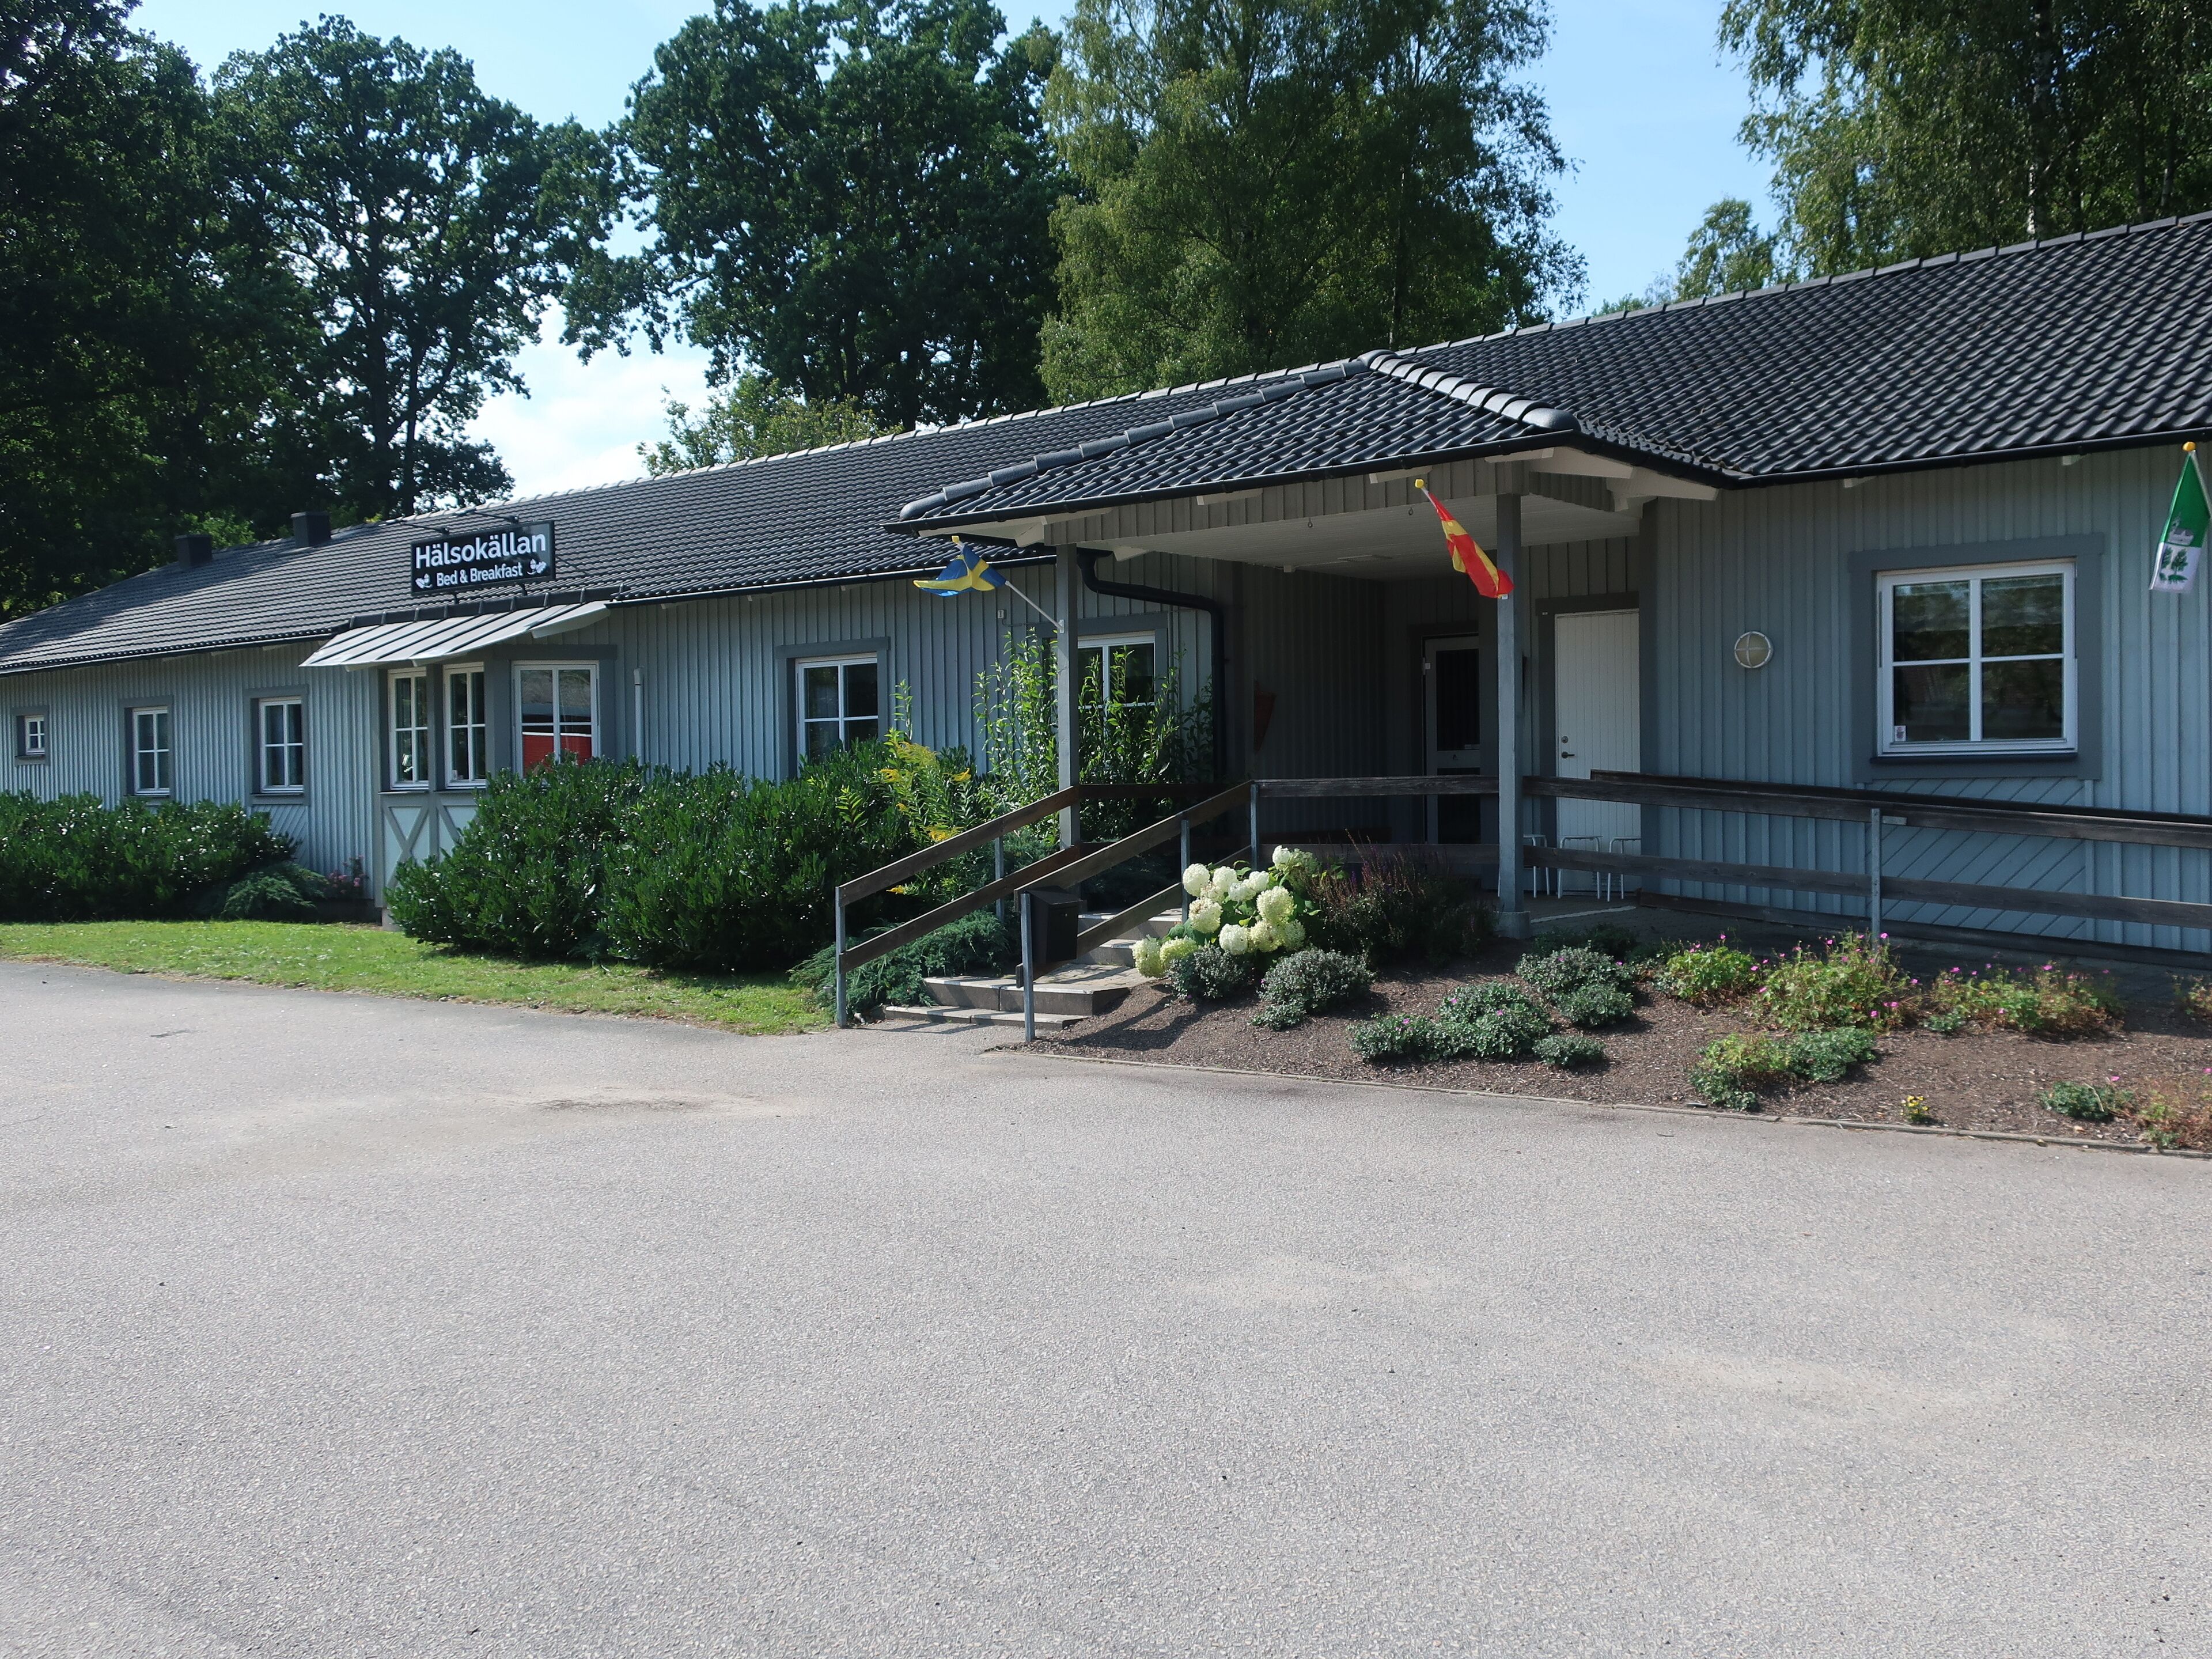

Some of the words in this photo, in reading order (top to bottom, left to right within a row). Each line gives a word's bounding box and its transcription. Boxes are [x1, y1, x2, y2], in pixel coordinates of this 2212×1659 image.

[415, 532, 546, 569] Hälsokällan
[437, 570, 457, 586] Bed
[460, 569, 468, 584] &
[470, 562, 523, 581] Breakfast
